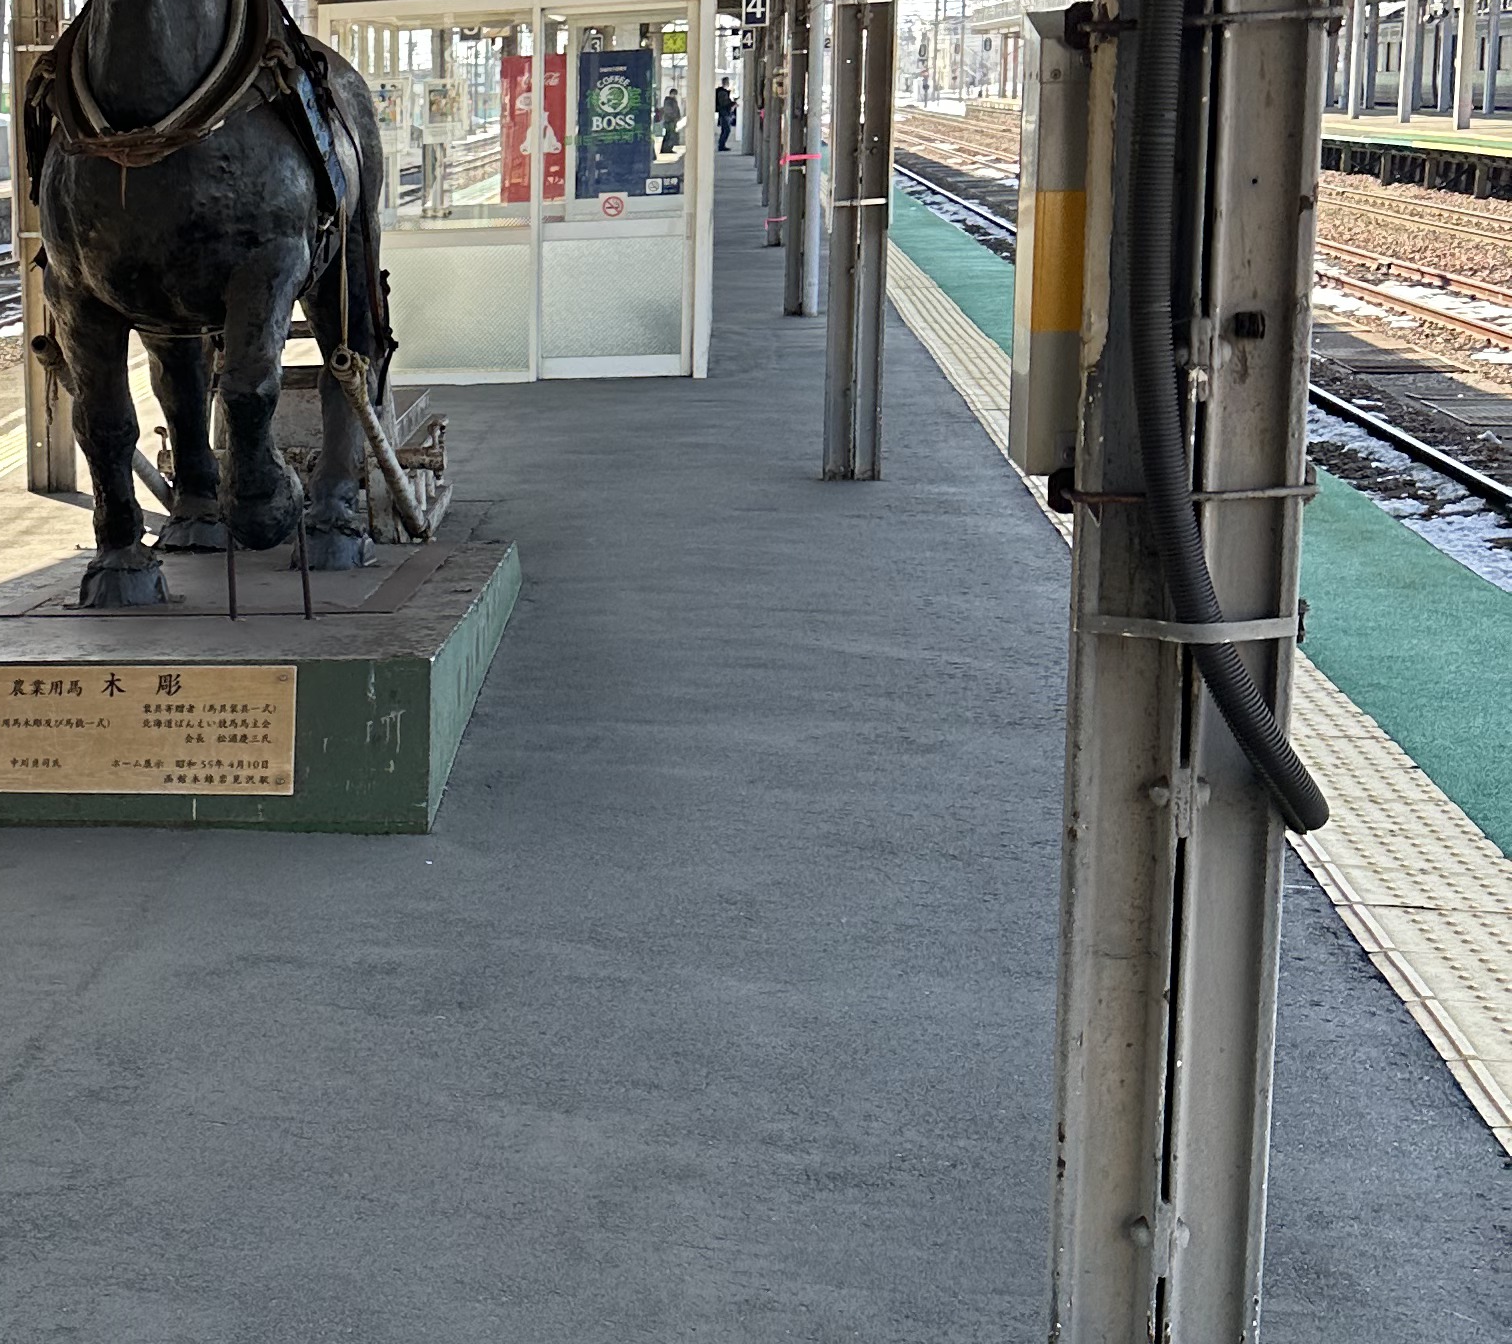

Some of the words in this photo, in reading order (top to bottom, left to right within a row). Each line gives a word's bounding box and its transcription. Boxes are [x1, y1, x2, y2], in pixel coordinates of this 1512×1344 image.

[742, 32, 753, 47] 4
[596, 75, 631, 88] COFFEE
[591, 114, 635, 131] BOSS
[8, 678, 83, 697] 農業用馬
